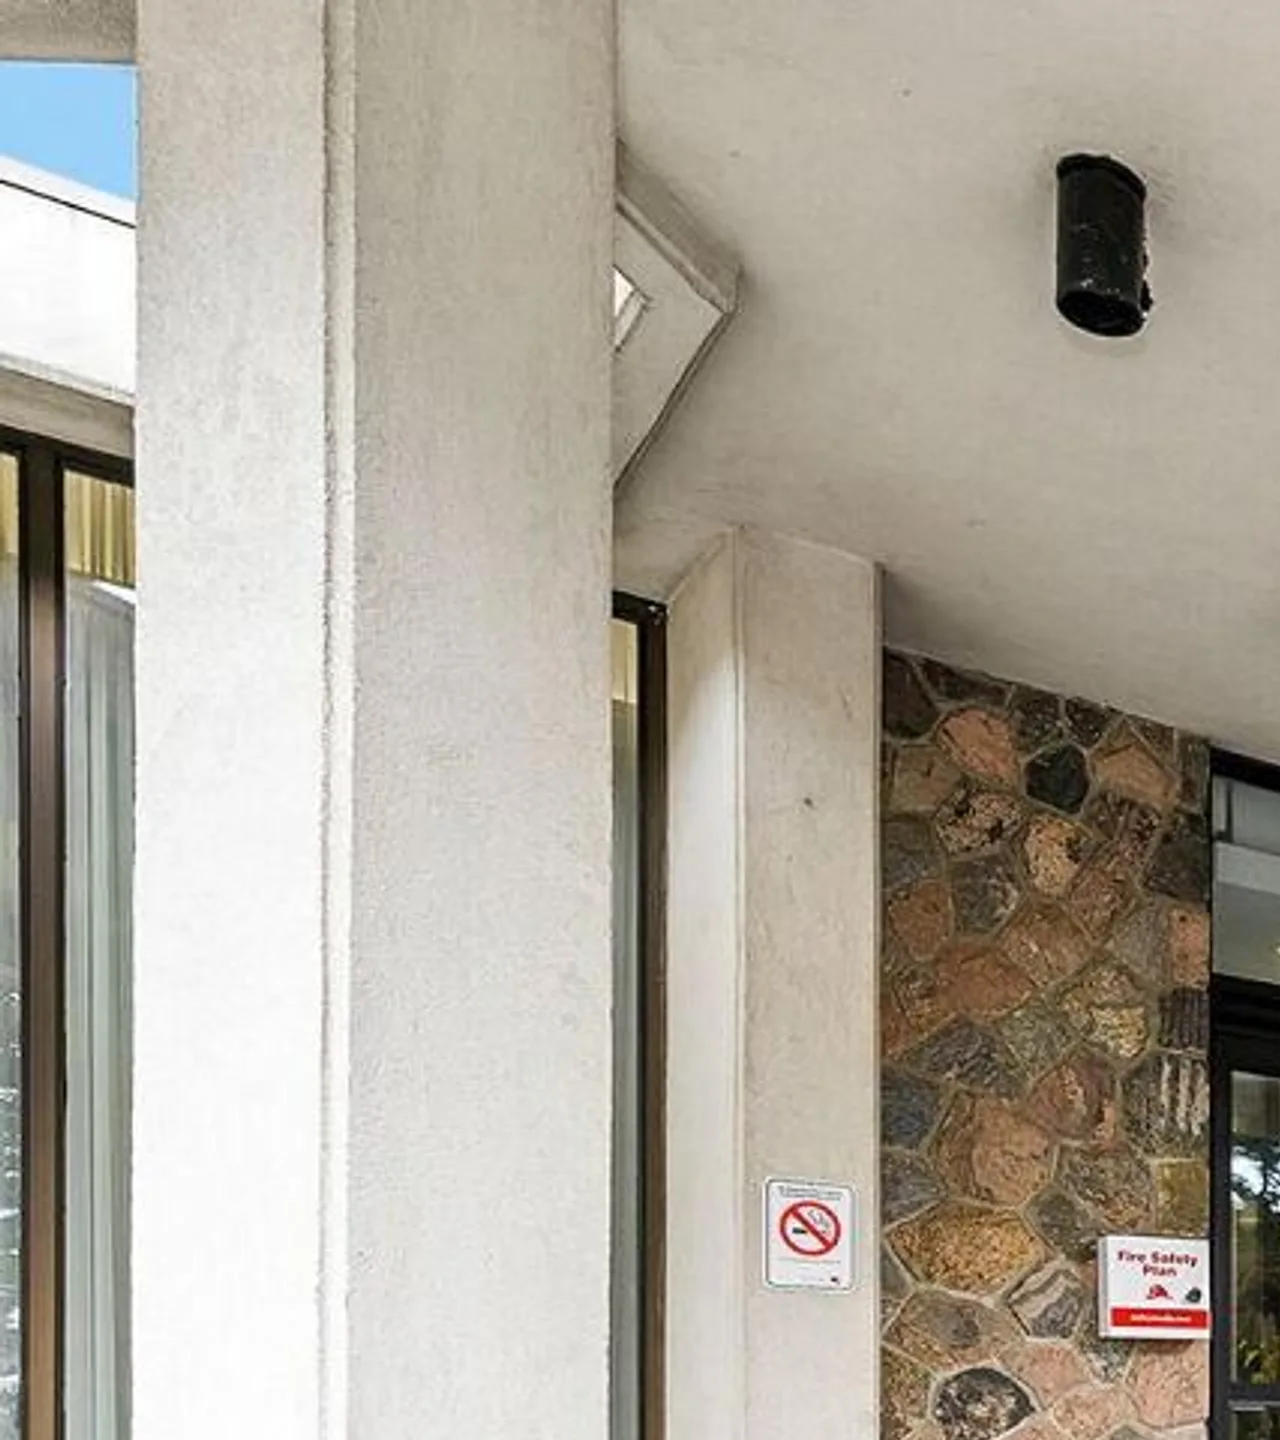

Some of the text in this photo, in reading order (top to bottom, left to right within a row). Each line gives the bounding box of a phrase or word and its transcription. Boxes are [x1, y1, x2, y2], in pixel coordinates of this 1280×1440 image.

[1117, 1250, 1198, 1268] Fire Safety
[1143, 1264, 1177, 1277] Plan
